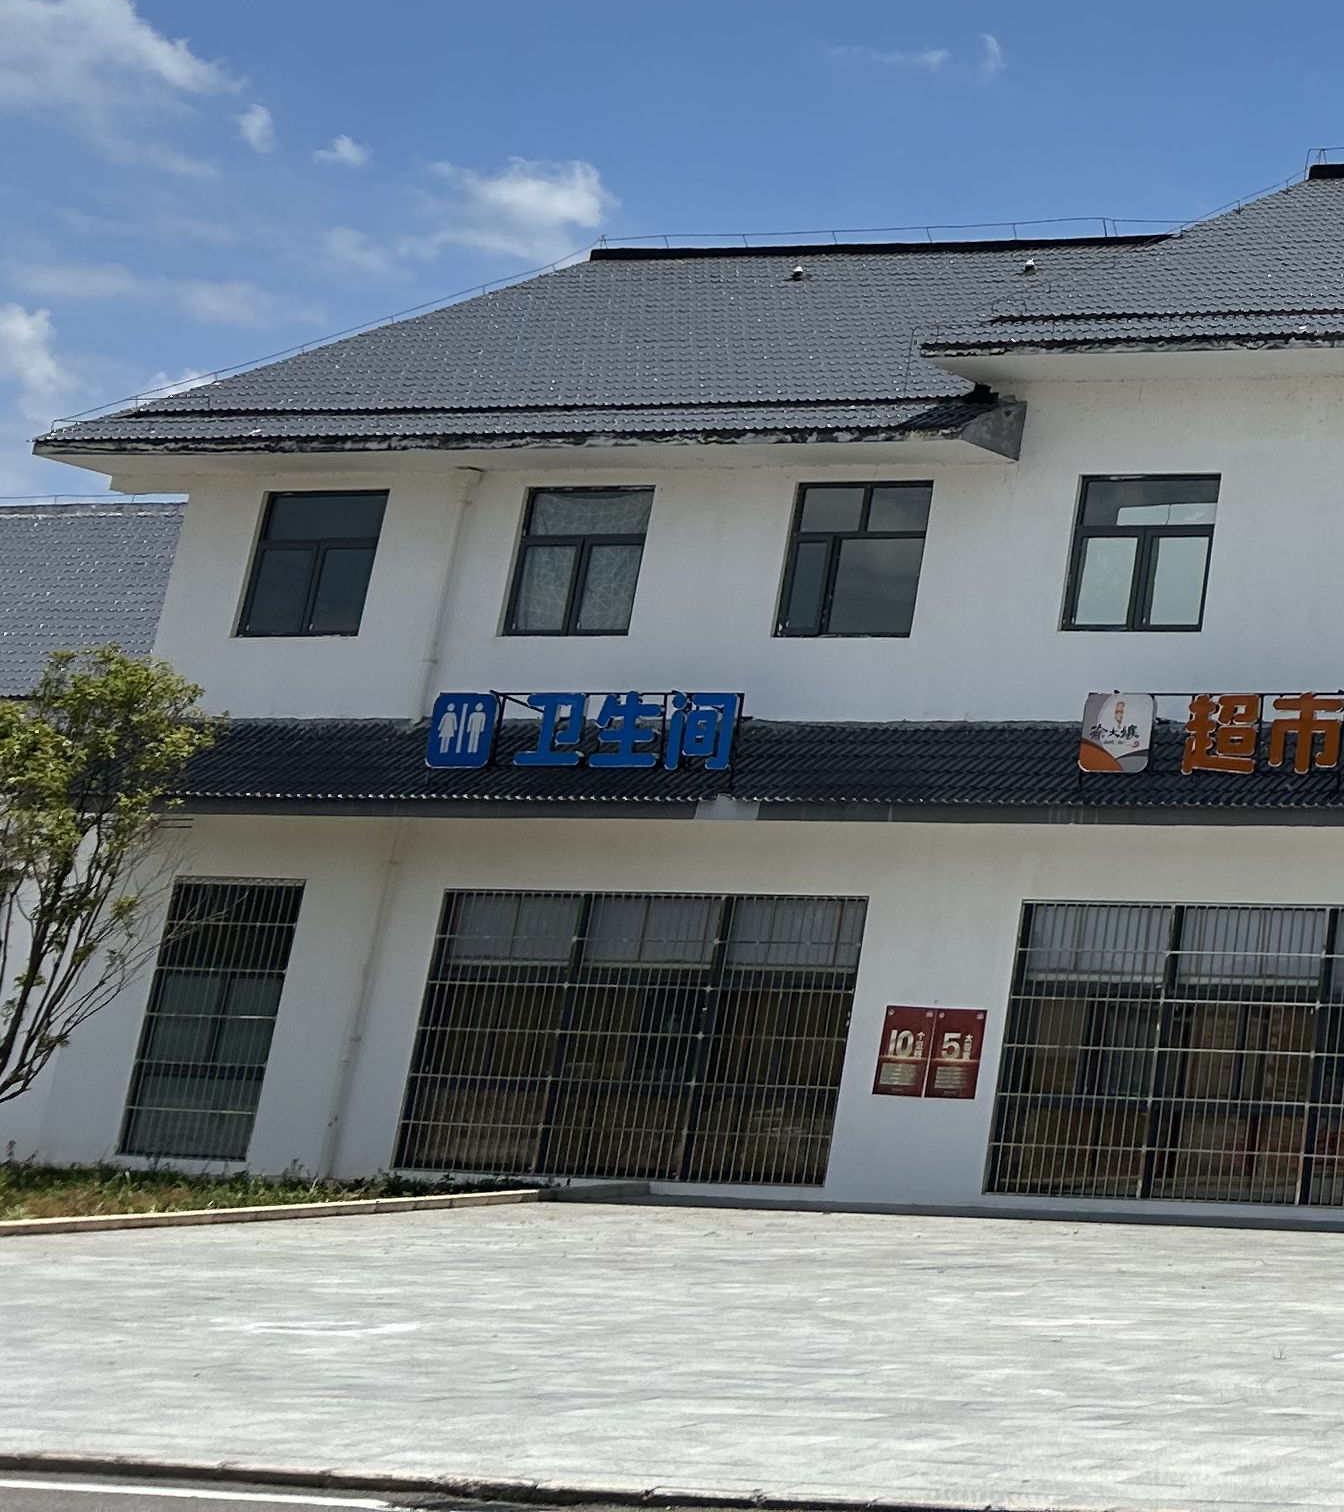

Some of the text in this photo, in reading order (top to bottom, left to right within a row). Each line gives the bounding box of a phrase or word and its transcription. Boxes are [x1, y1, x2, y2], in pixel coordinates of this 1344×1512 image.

[513, 690, 739, 770] 卫生间
[888, 1029, 915, 1058] 10
[941, 1032, 962, 1059] 5
